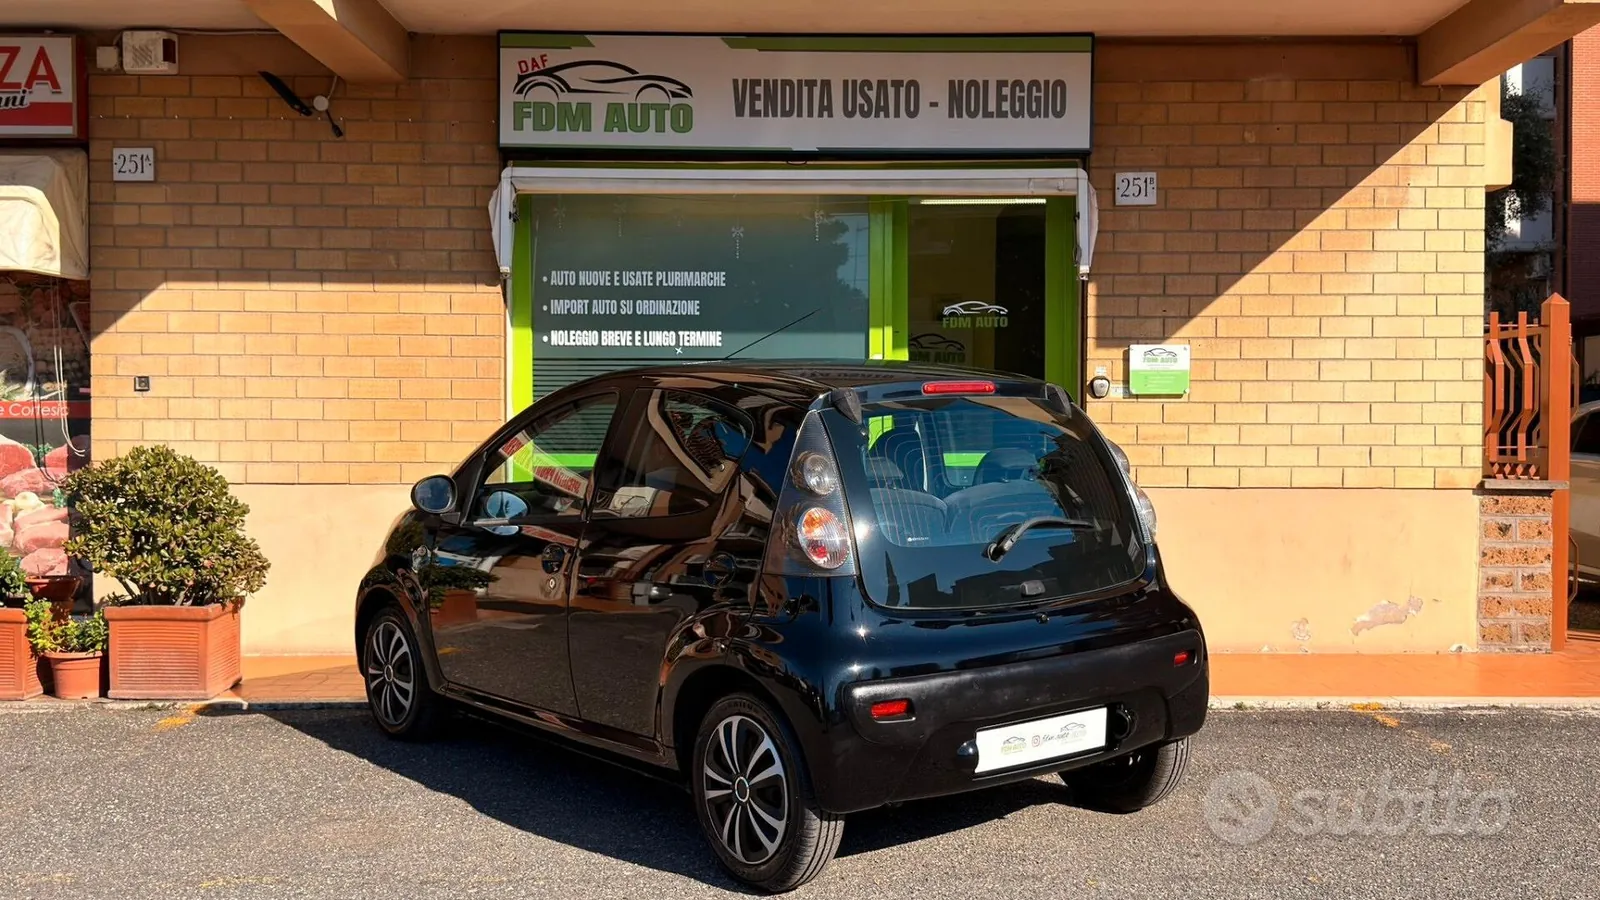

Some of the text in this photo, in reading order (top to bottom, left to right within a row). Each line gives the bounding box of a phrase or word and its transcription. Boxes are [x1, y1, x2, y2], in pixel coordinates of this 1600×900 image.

[517, 54, 549, 74] DAF
[732, 78, 834, 118] VENDITA
[842, 79, 920, 119] USATO
[948, 79, 1067, 119] NOLEGGIO
[513, 101, 693, 134] FDM AUTO
[551, 270, 726, 287] AUTO NUOVE E USATE PLURIMARCHE
[551, 299, 700, 316] IMPORT AUTO SU ORDINAZIONE
[943, 316, 1008, 328] FDM AUTO
[551, 330, 722, 347] NOLEGGIO BREVE E LUNGO TERMINE
